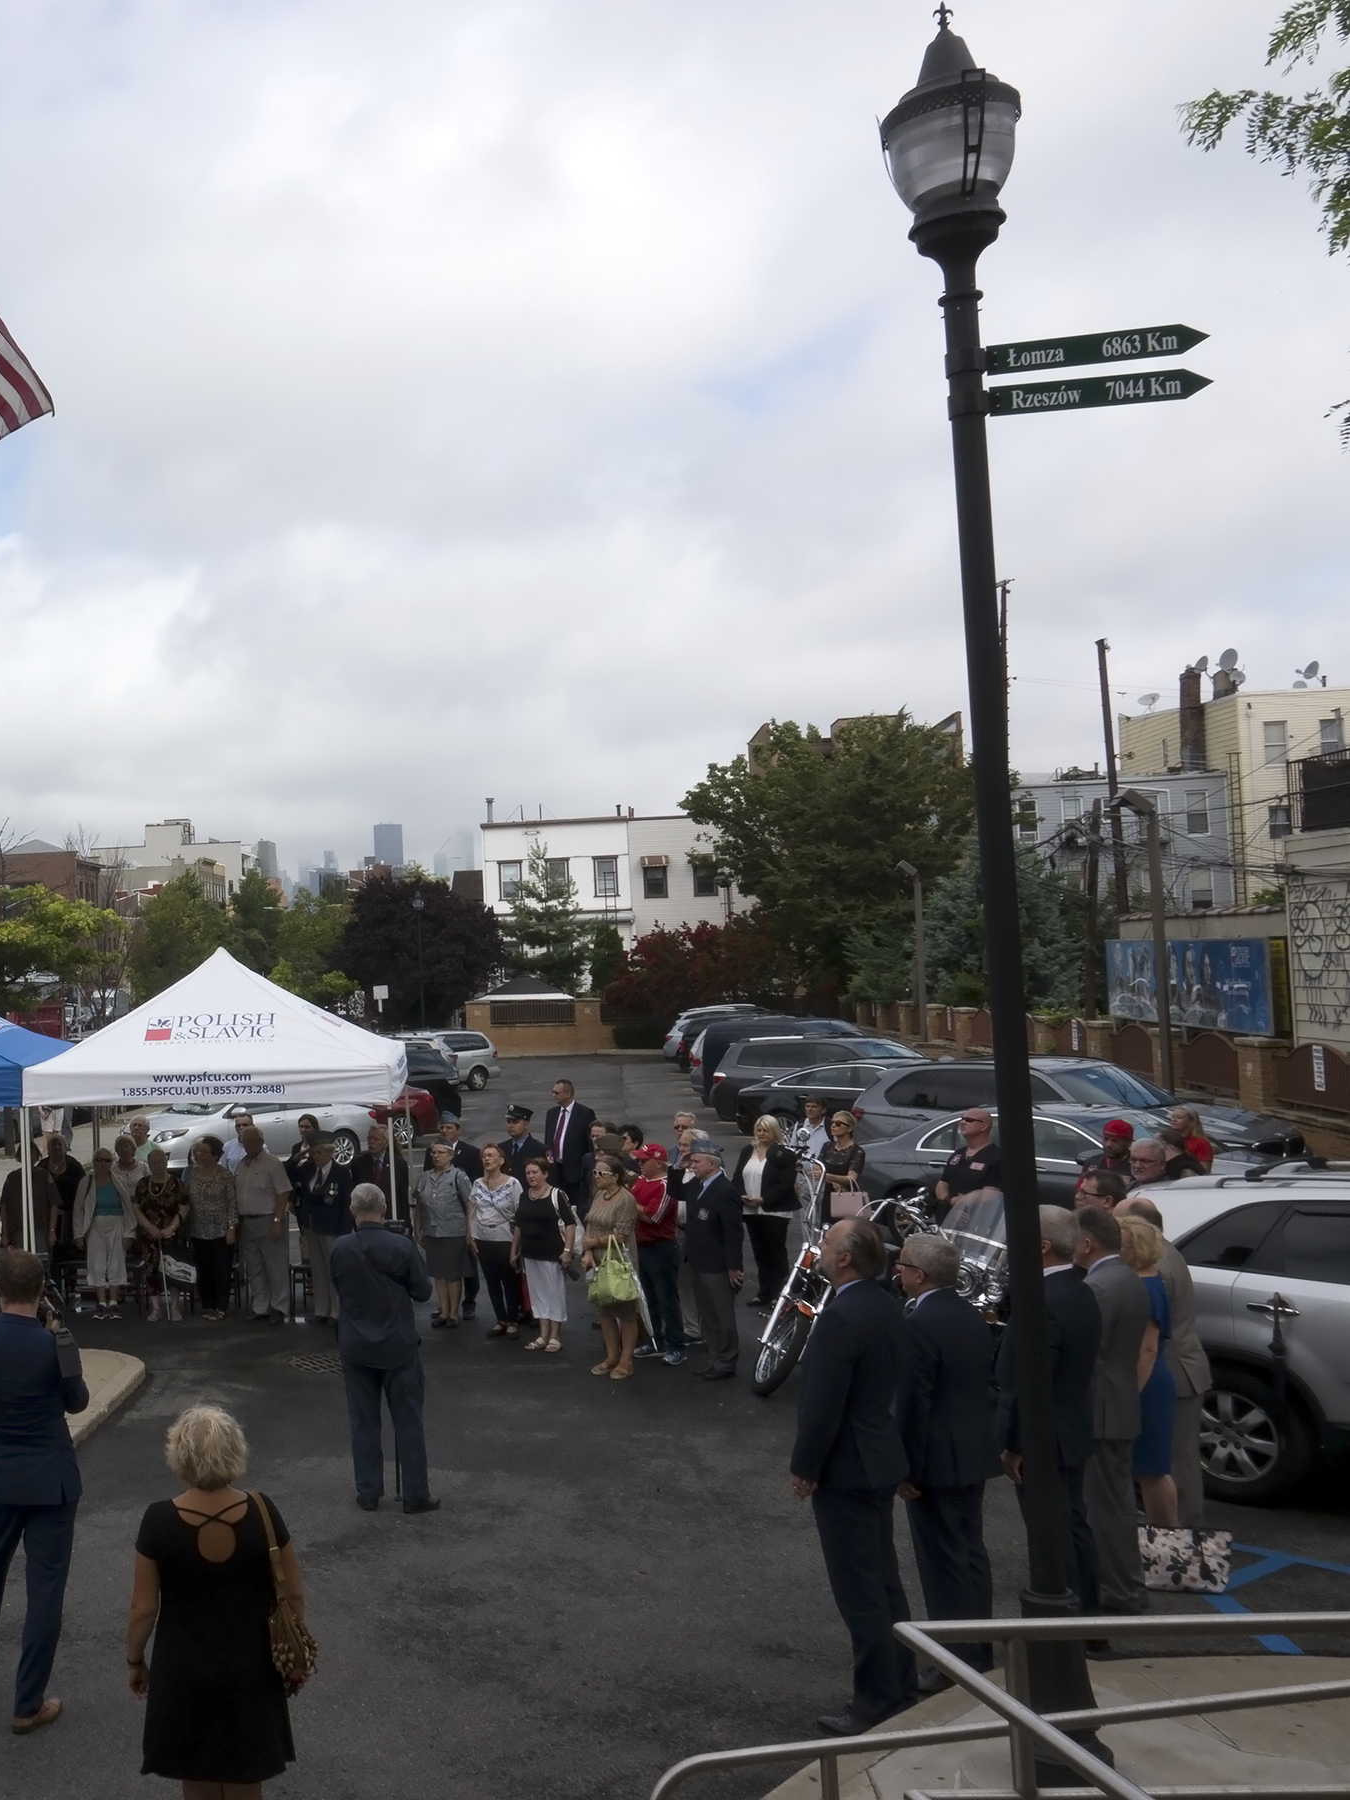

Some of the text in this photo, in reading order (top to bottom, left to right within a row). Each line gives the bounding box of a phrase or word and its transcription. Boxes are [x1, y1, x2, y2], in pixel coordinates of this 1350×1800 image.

[1102, 334, 1141, 357] 6863
[1147, 332, 1178, 352] Km
[1011, 376, 1182, 409] Rzeszów 7044 Km
[177, 1012, 277, 1028] POLISH
[152, 1071, 251, 1085] www.psfcu.com
[121, 1084, 286, 1097] 1.855.PSFCU.4U (1.855.773.2848)
